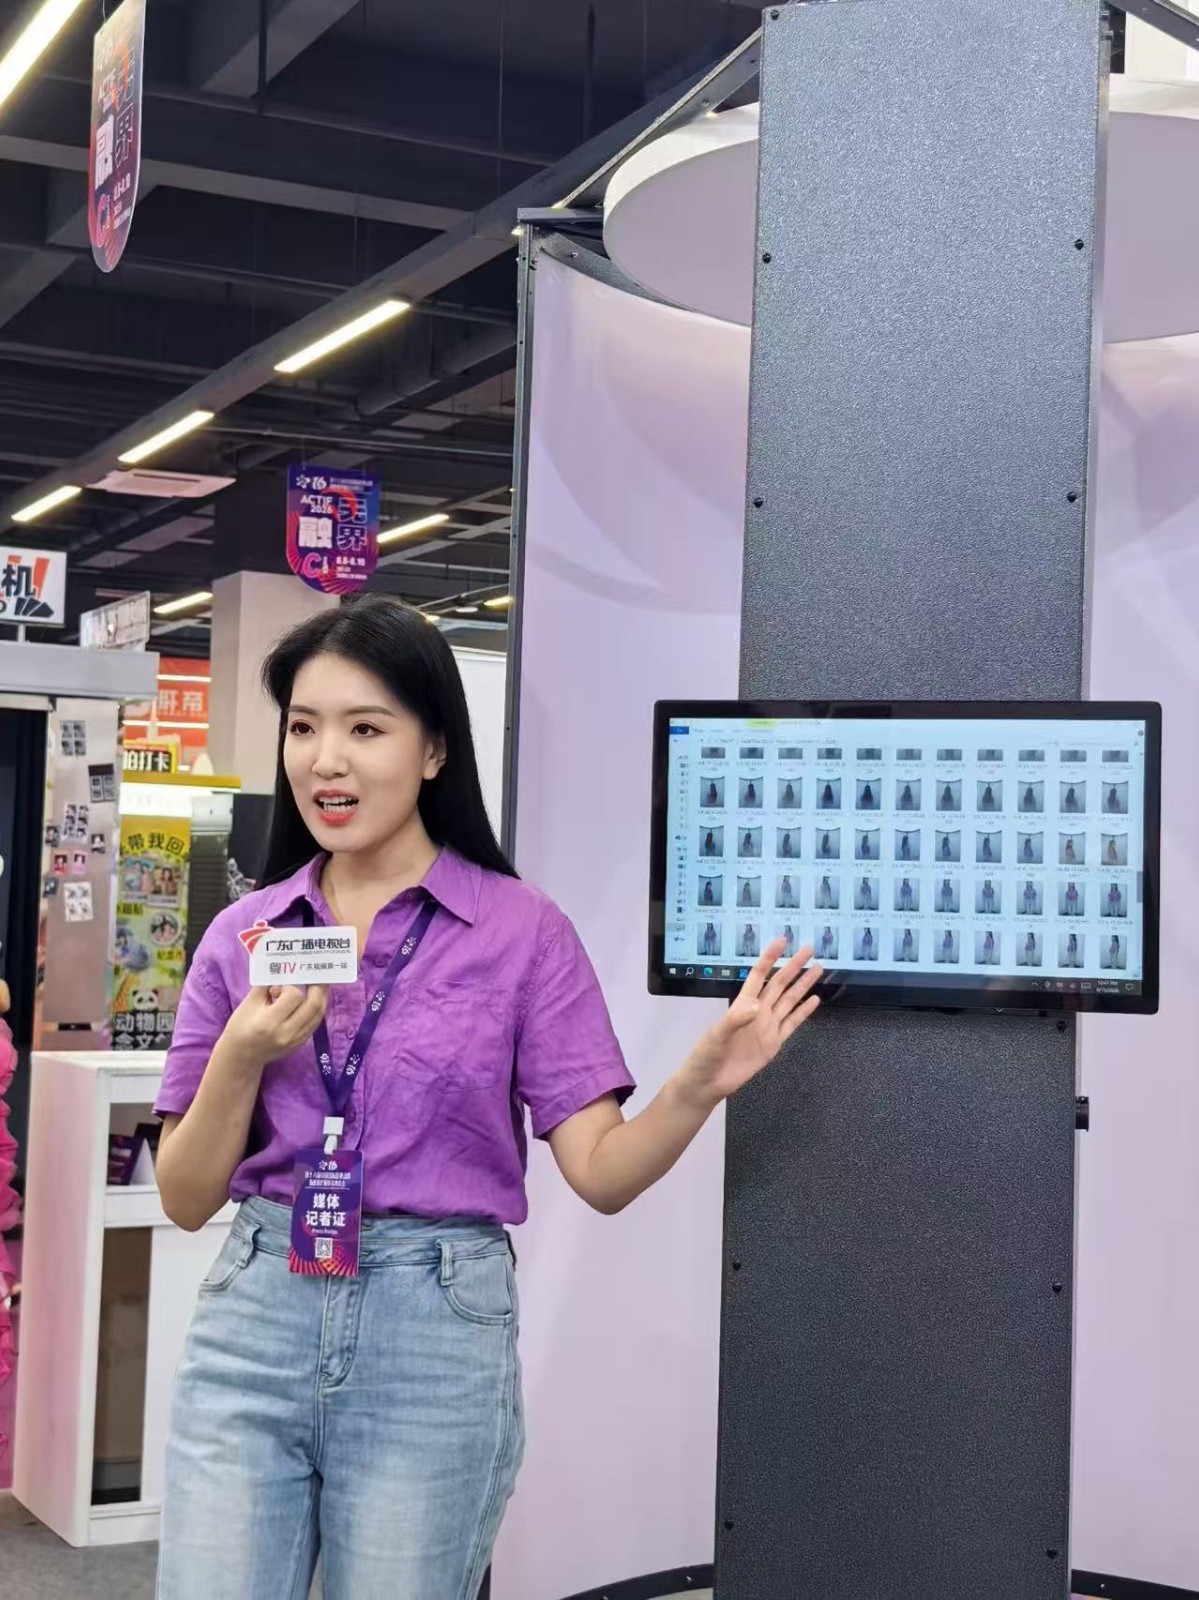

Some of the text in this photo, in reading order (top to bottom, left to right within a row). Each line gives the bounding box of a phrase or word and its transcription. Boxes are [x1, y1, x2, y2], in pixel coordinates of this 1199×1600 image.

[266, 938, 351, 951] 广东广播电视台
[115, 1012, 175, 1032] 动物园
[313, 1193, 340, 1209] 媒体
[306, 1210, 346, 1227] 记者证
